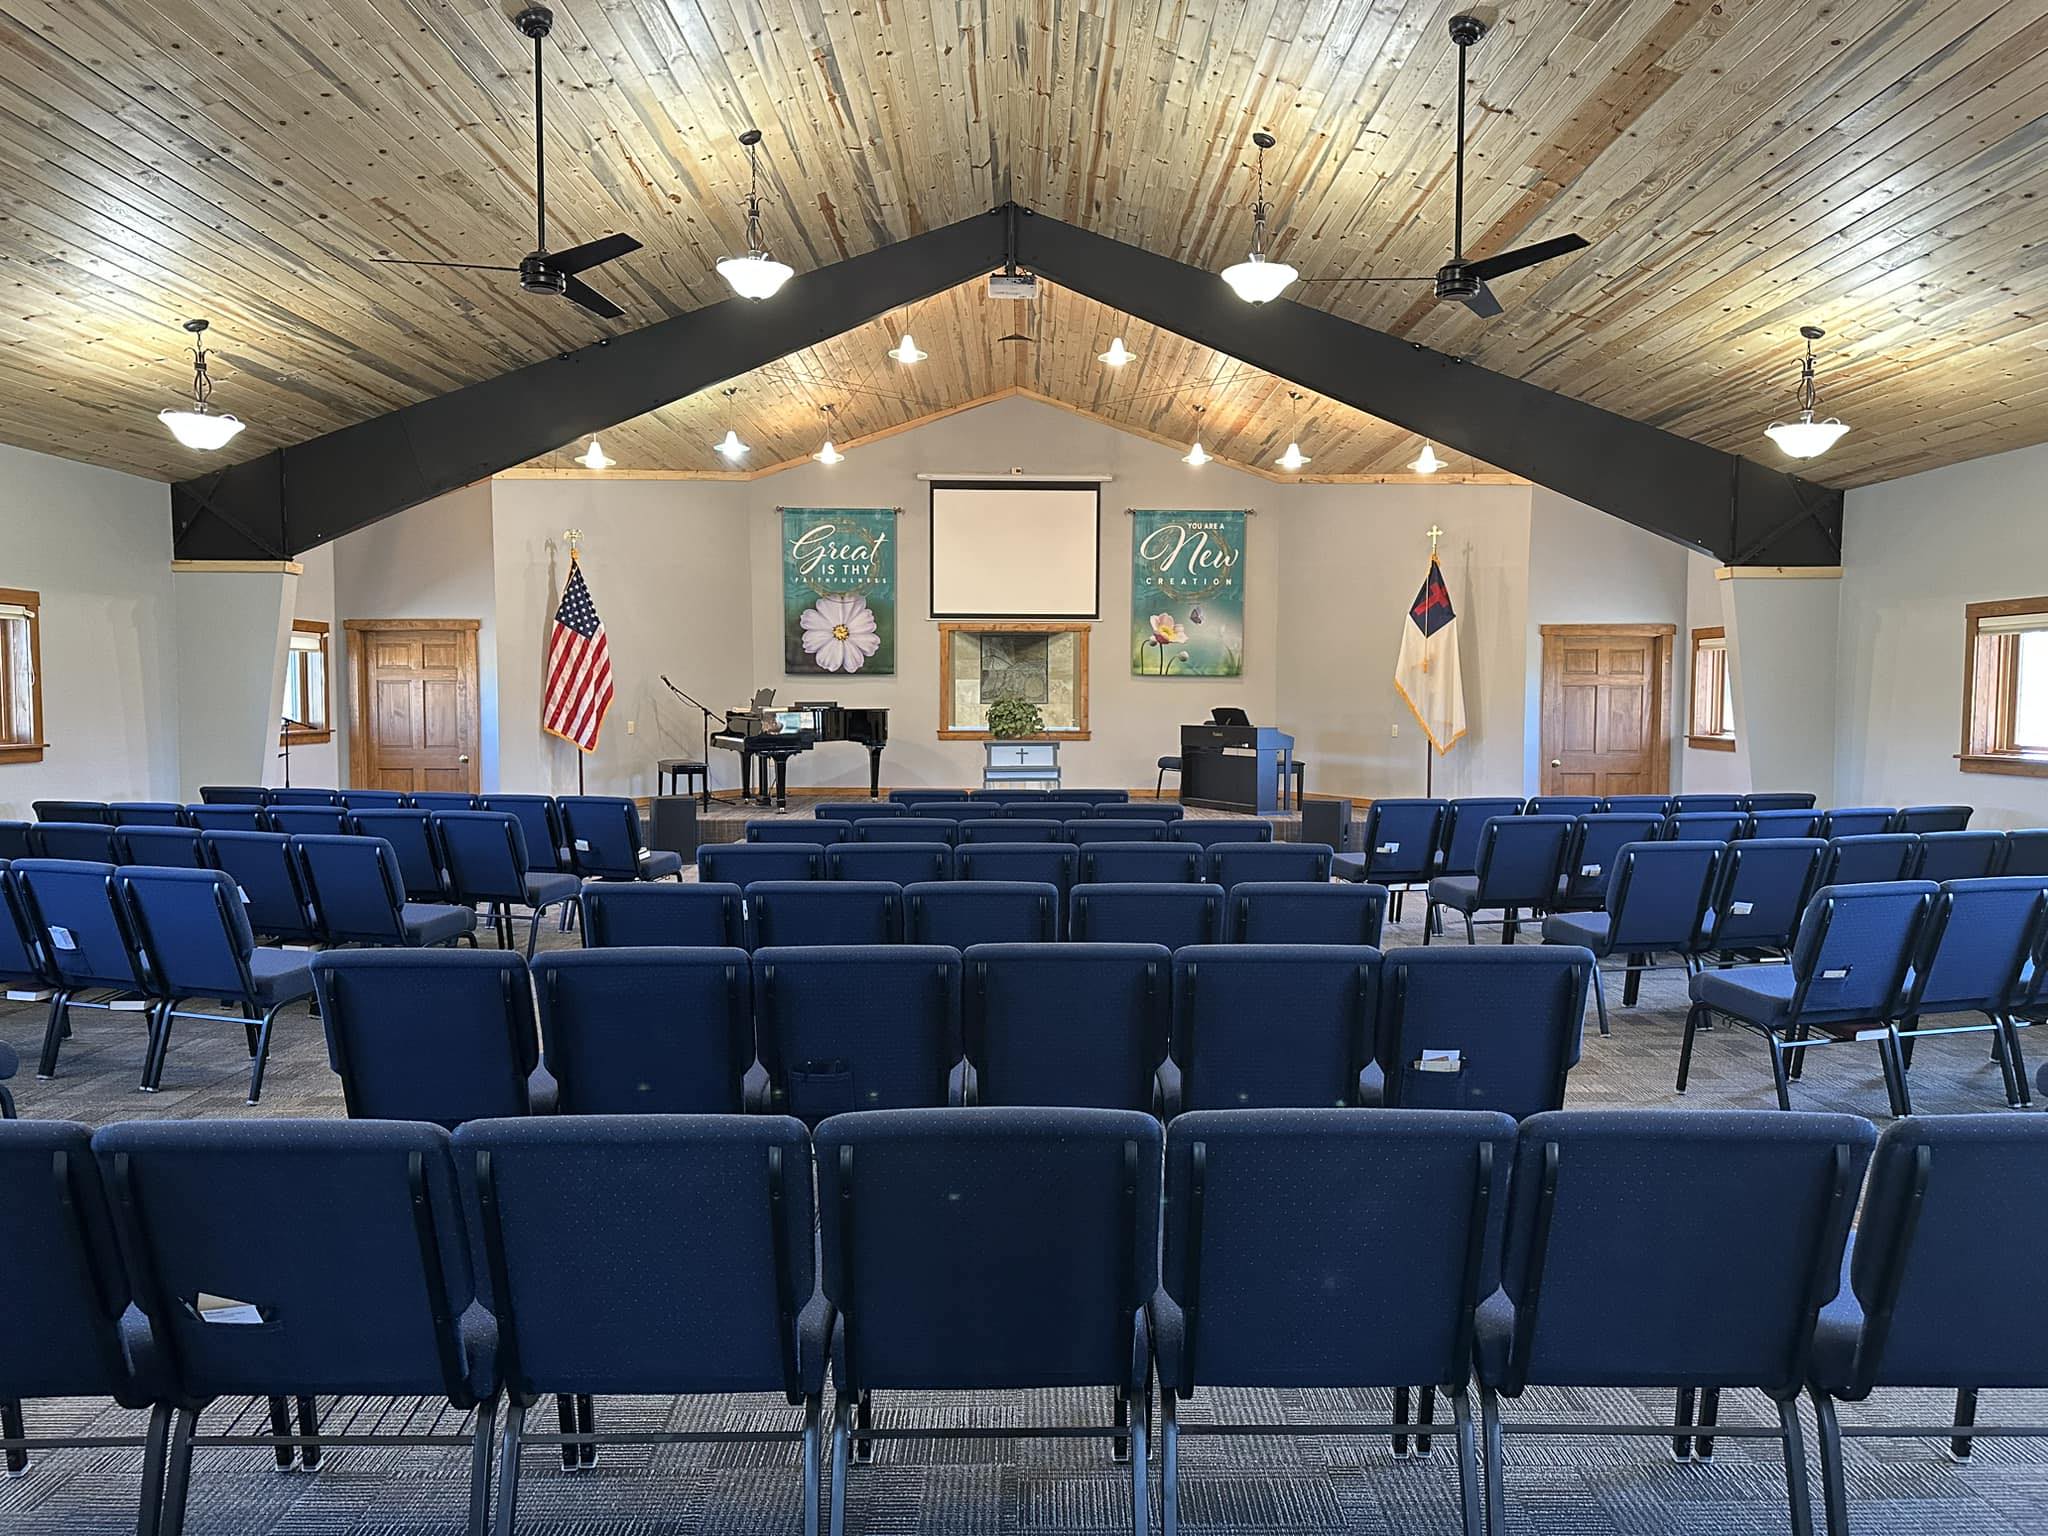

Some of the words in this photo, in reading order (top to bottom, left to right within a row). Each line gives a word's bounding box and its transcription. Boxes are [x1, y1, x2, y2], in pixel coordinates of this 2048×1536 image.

[1188, 522, 1202, 530] YOU
[1204, 522, 1218, 530] ARE
[1219, 522, 1225, 530] A
[789, 524, 889, 575] Great
[1140, 525, 1239, 575] New
[822, 564, 835, 575] IS
[842, 564, 870, 575] THY
[1145, 577, 1232, 585] CREATION
